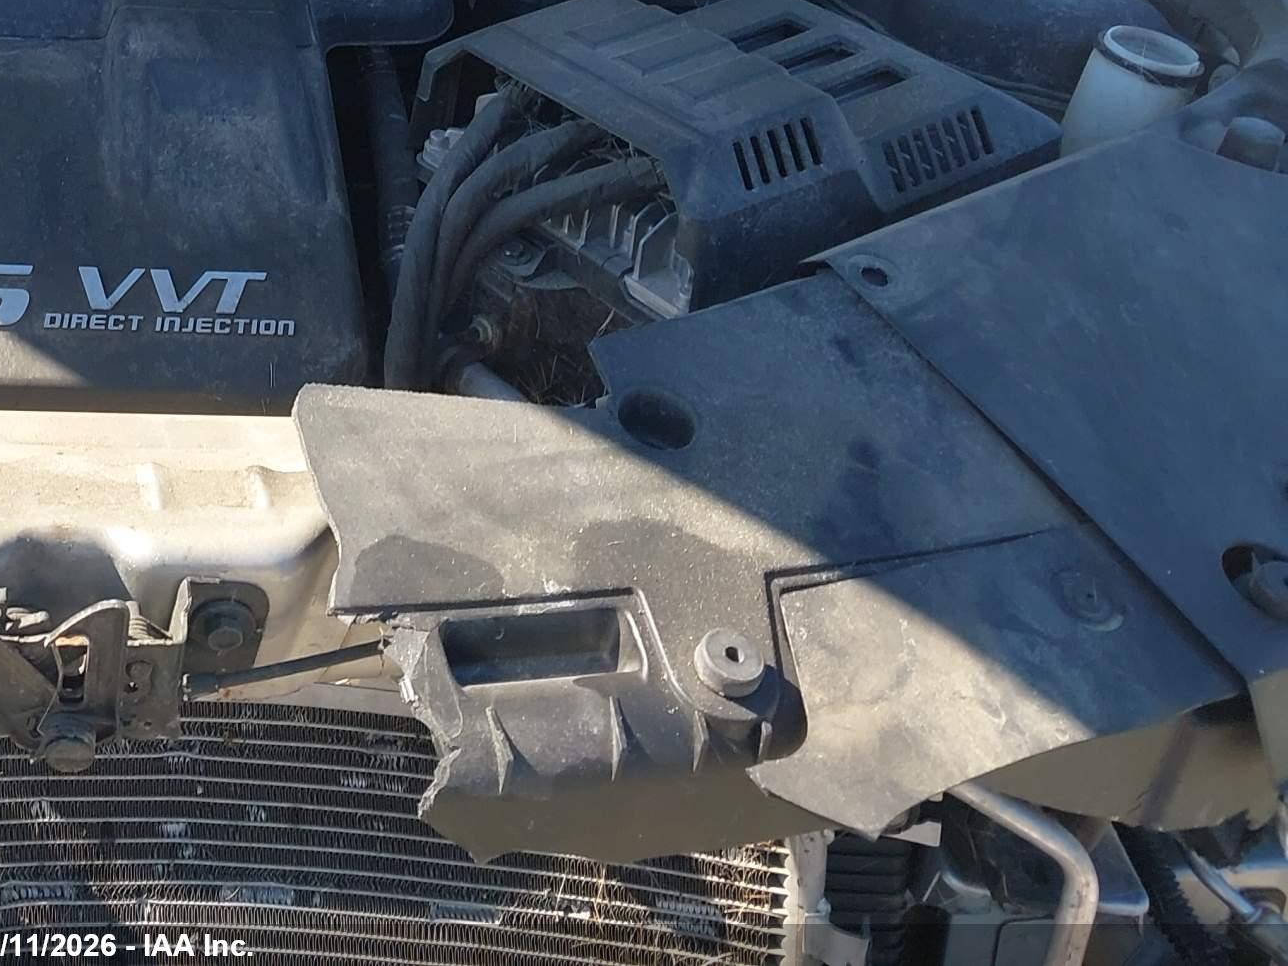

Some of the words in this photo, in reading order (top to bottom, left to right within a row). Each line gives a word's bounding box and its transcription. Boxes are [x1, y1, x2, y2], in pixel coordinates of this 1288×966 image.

[78, 266, 267, 315] VVT
[43, 313, 144, 332] DIRECT
[154, 315, 296, 336] INJECTION
